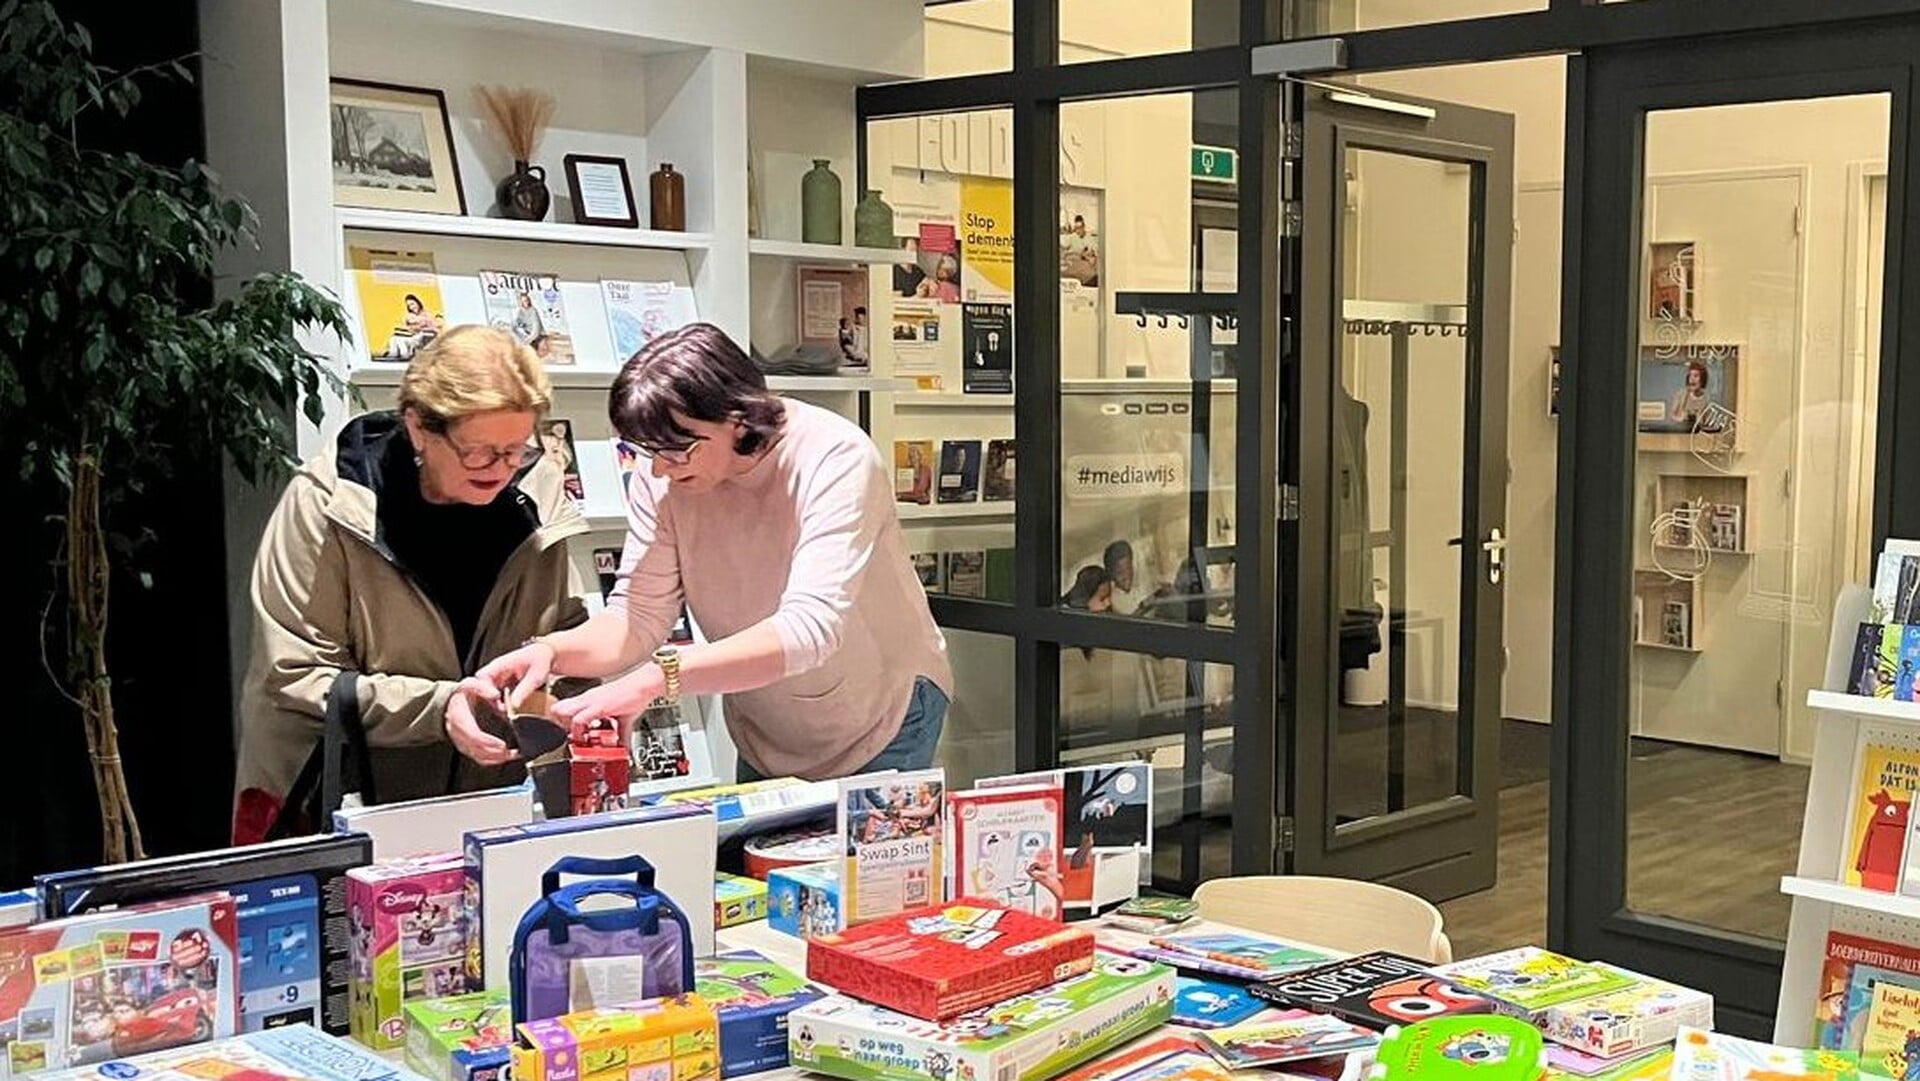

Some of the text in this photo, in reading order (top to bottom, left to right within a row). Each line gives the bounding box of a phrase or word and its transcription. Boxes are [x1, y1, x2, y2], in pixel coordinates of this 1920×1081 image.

[966, 213, 995, 232] Stop
[1078, 465, 1176, 488] #mediawijs
[1881, 773, 1903, 787] DAT
[860, 842, 930, 862] Swap Sint
[1280, 966, 1381, 1003] SUPER
[859, 1038, 904, 1054] op weg
[854, 1051, 881, 1062] naar
[884, 1054, 919, 1070] groep
